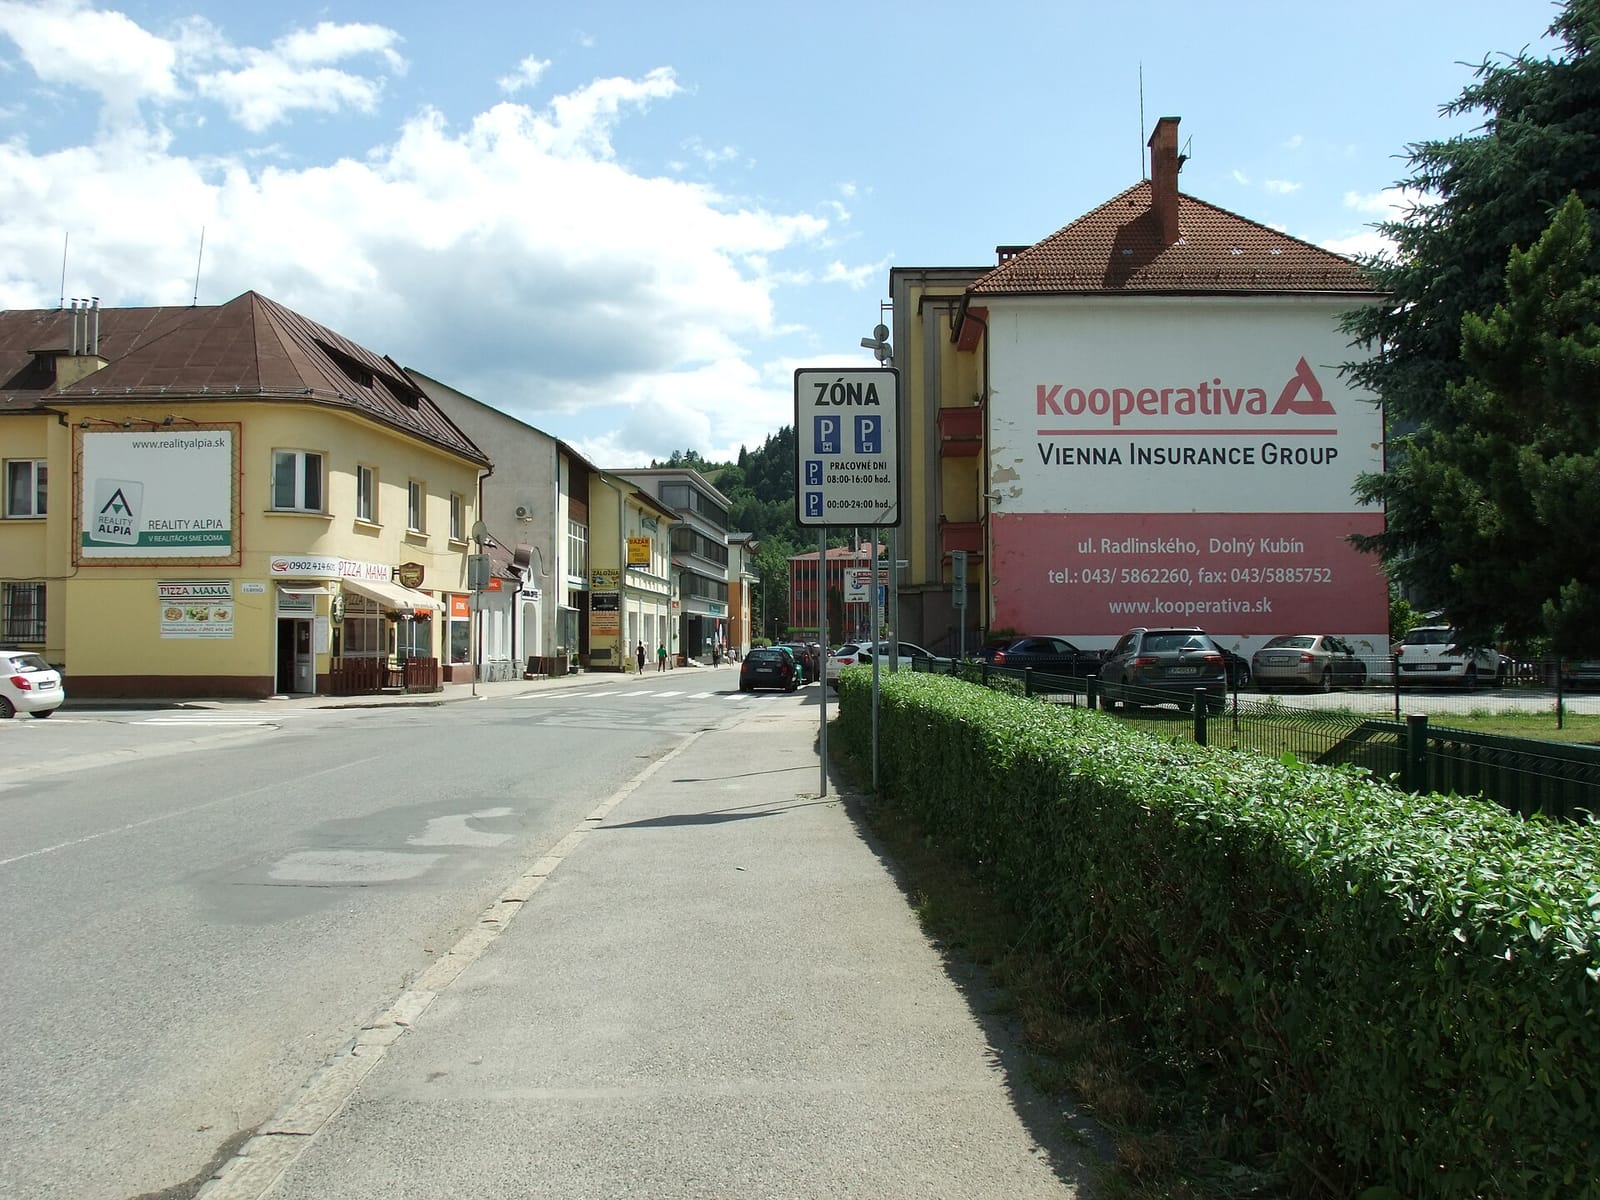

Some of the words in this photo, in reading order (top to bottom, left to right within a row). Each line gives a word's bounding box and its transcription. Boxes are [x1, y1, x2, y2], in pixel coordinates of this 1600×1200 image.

[813, 377, 881, 407] ZÓNA
[1036, 377, 1268, 426] Kooperativa
[820, 419, 834, 442] P
[861, 419, 874, 442] P
[132, 437, 225, 450] www.realityalpia.sk
[1037, 442, 1123, 466] VIENNA
[1129, 442, 1255, 466] INSURANCE
[1261, 442, 1339, 466] GROUP
[830, 459, 872, 471] PRACOVNÉ
[826, 474, 873, 484] 08:00-16:00
[874, 474, 891, 484] hod.
[826, 500, 873, 509] 00:00-24:00
[874, 500, 891, 509] hod.
[98, 516, 133, 525] REALITY
[148, 519, 190, 530] REALITY
[193, 519, 224, 529] ALPIA
[98, 525, 132, 535] ALPIA
[1078, 538, 1097, 555] ul.
[1101, 537, 1200, 557] Radlinského,
[1209, 537, 1256, 558] Dolný
[1260, 537, 1305, 555] Kubín
[289, 561, 311, 570] 0902
[338, 560, 362, 577] PIZZA
[365, 563, 388, 580] MAMA
[1048, 568, 1079, 584] tel.:
[1081, 568, 1116, 585] 043/
[1120, 568, 1193, 587] 5862260,
[1198, 567, 1227, 584] fax:
[1230, 568, 1332, 585] 043/5885752
[160, 587, 190, 595] PIZZA
[192, 586, 229, 595] MAMA
[1108, 597, 1273, 617] www.kooperativa.sk
